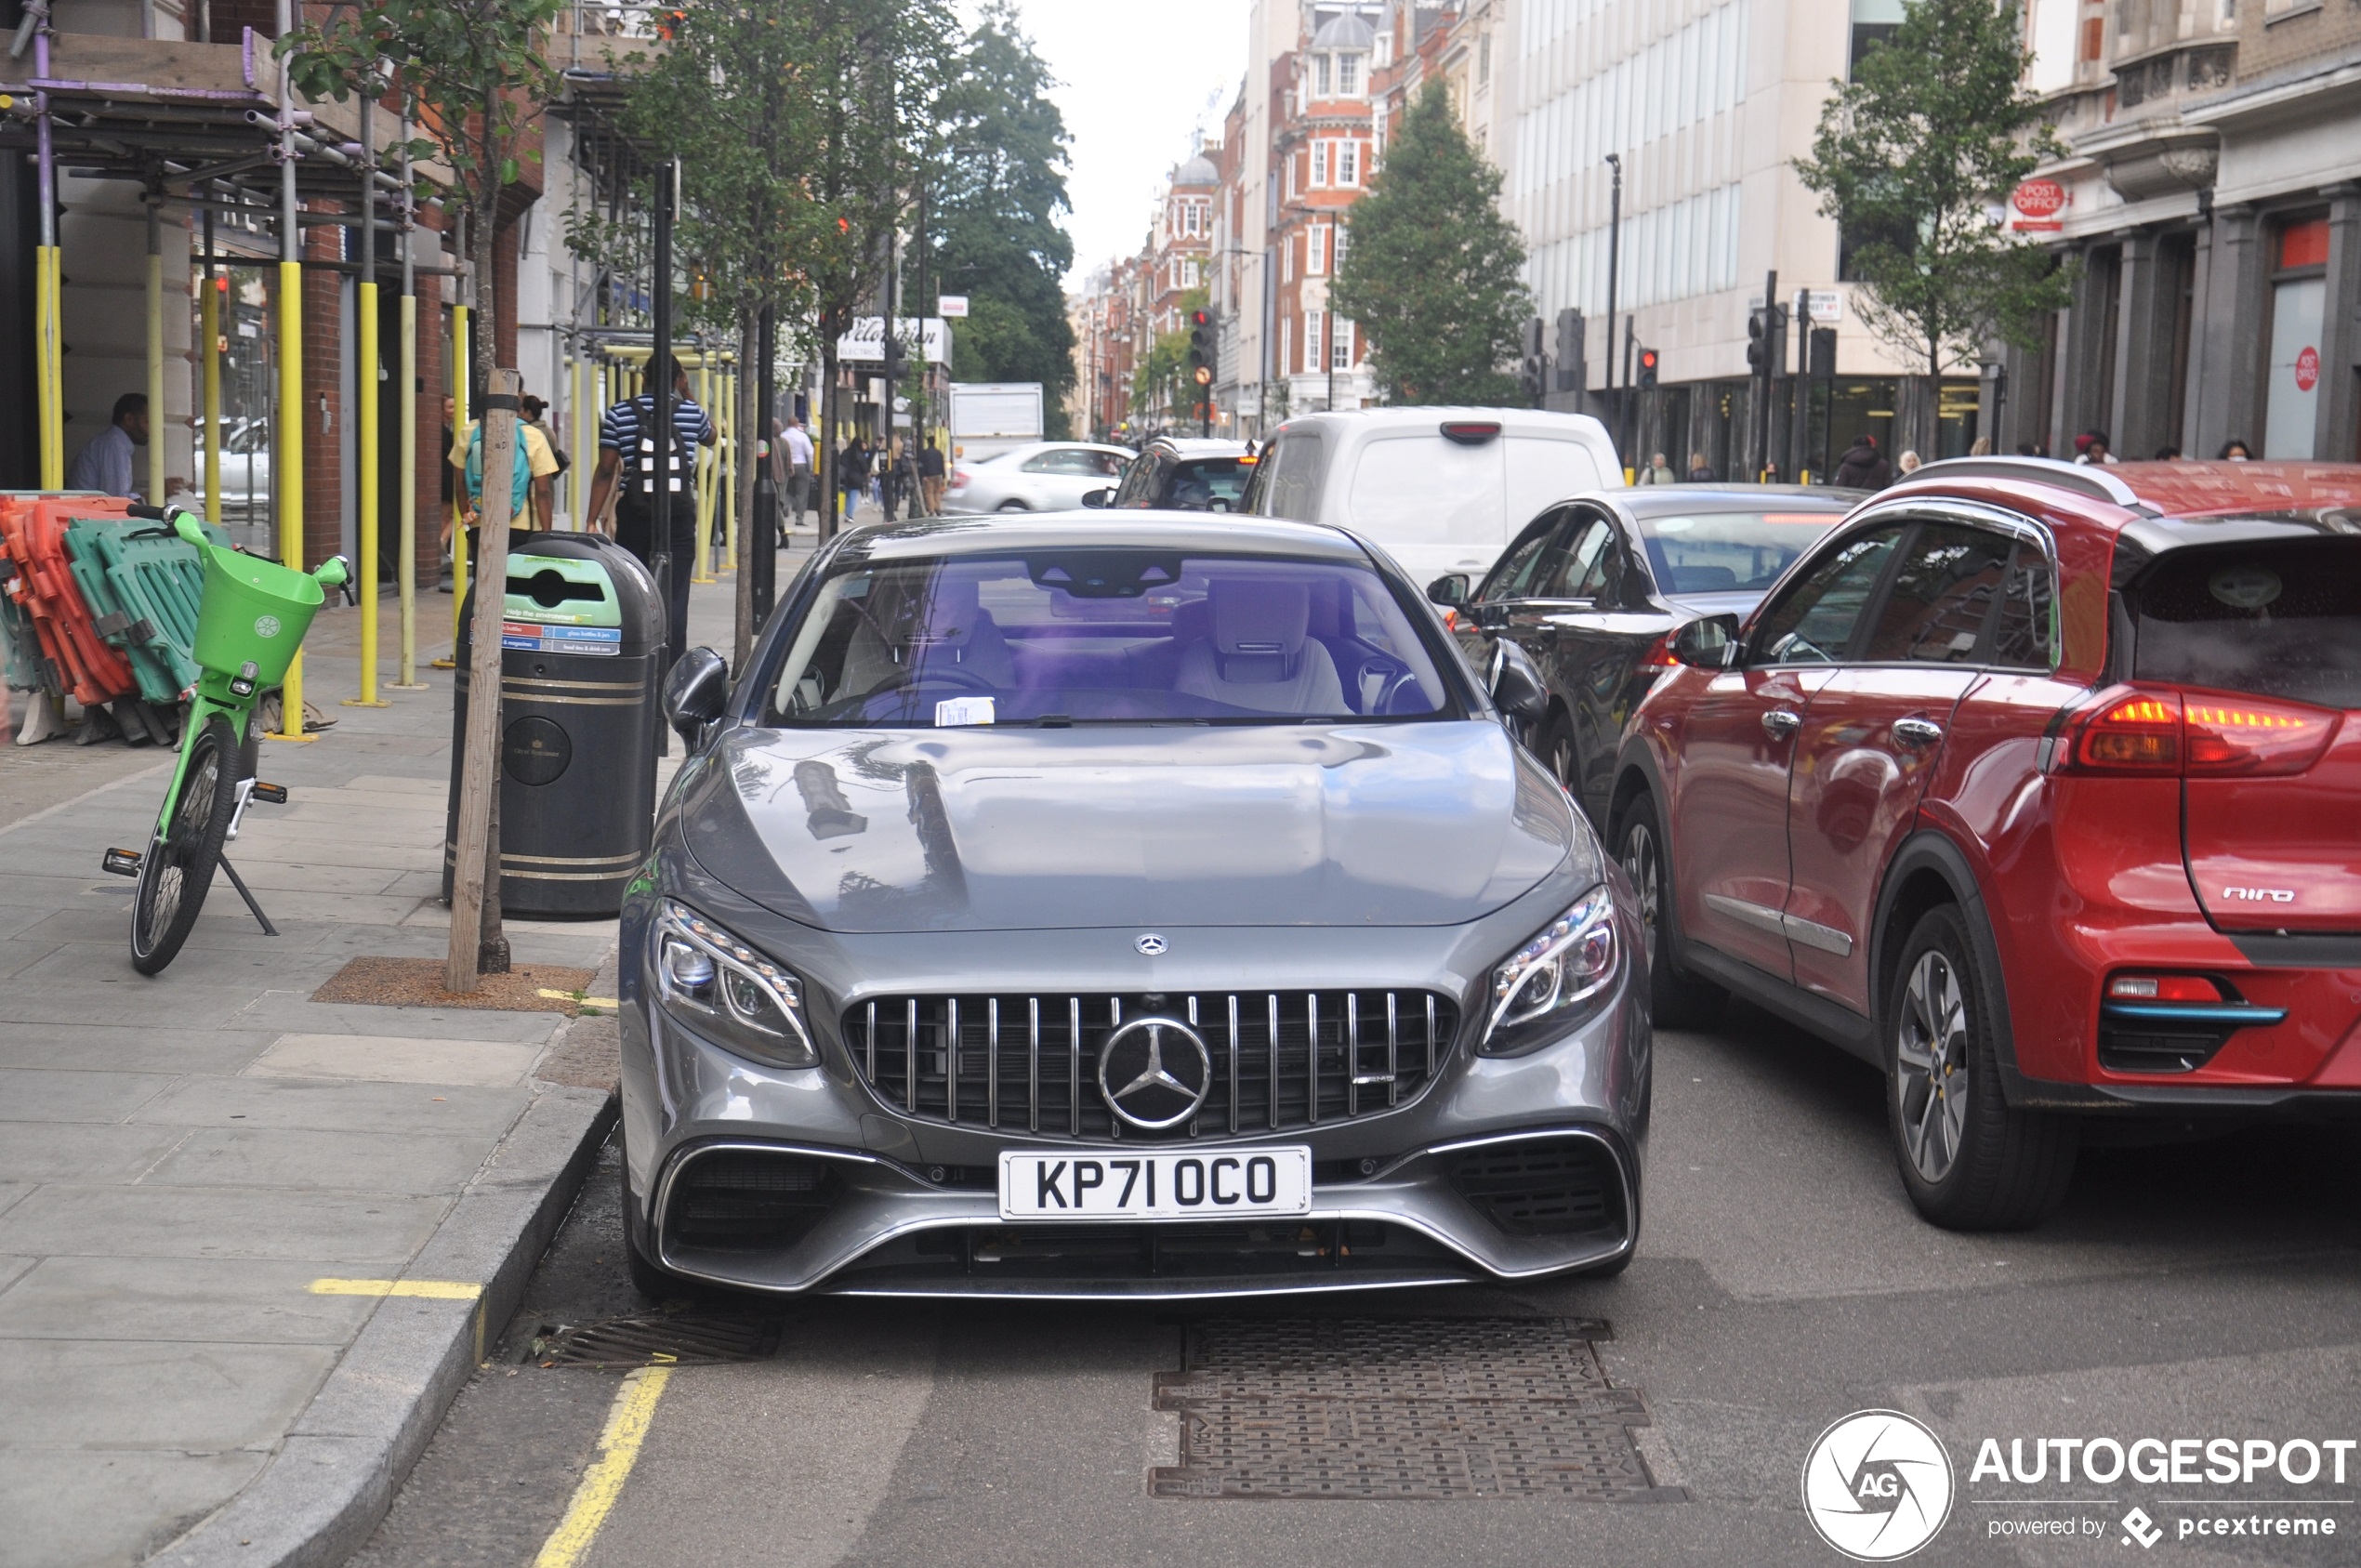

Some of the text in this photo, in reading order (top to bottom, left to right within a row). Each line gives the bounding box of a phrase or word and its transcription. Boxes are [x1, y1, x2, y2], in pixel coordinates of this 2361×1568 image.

[2025, 185, 2056, 197] POST
[2017, 196, 2061, 209] OFFICE
[506, 608, 522, 617] Help
[534, 613, 575, 622] environment
[1036, 1155, 1277, 1209] KP71 OCO
